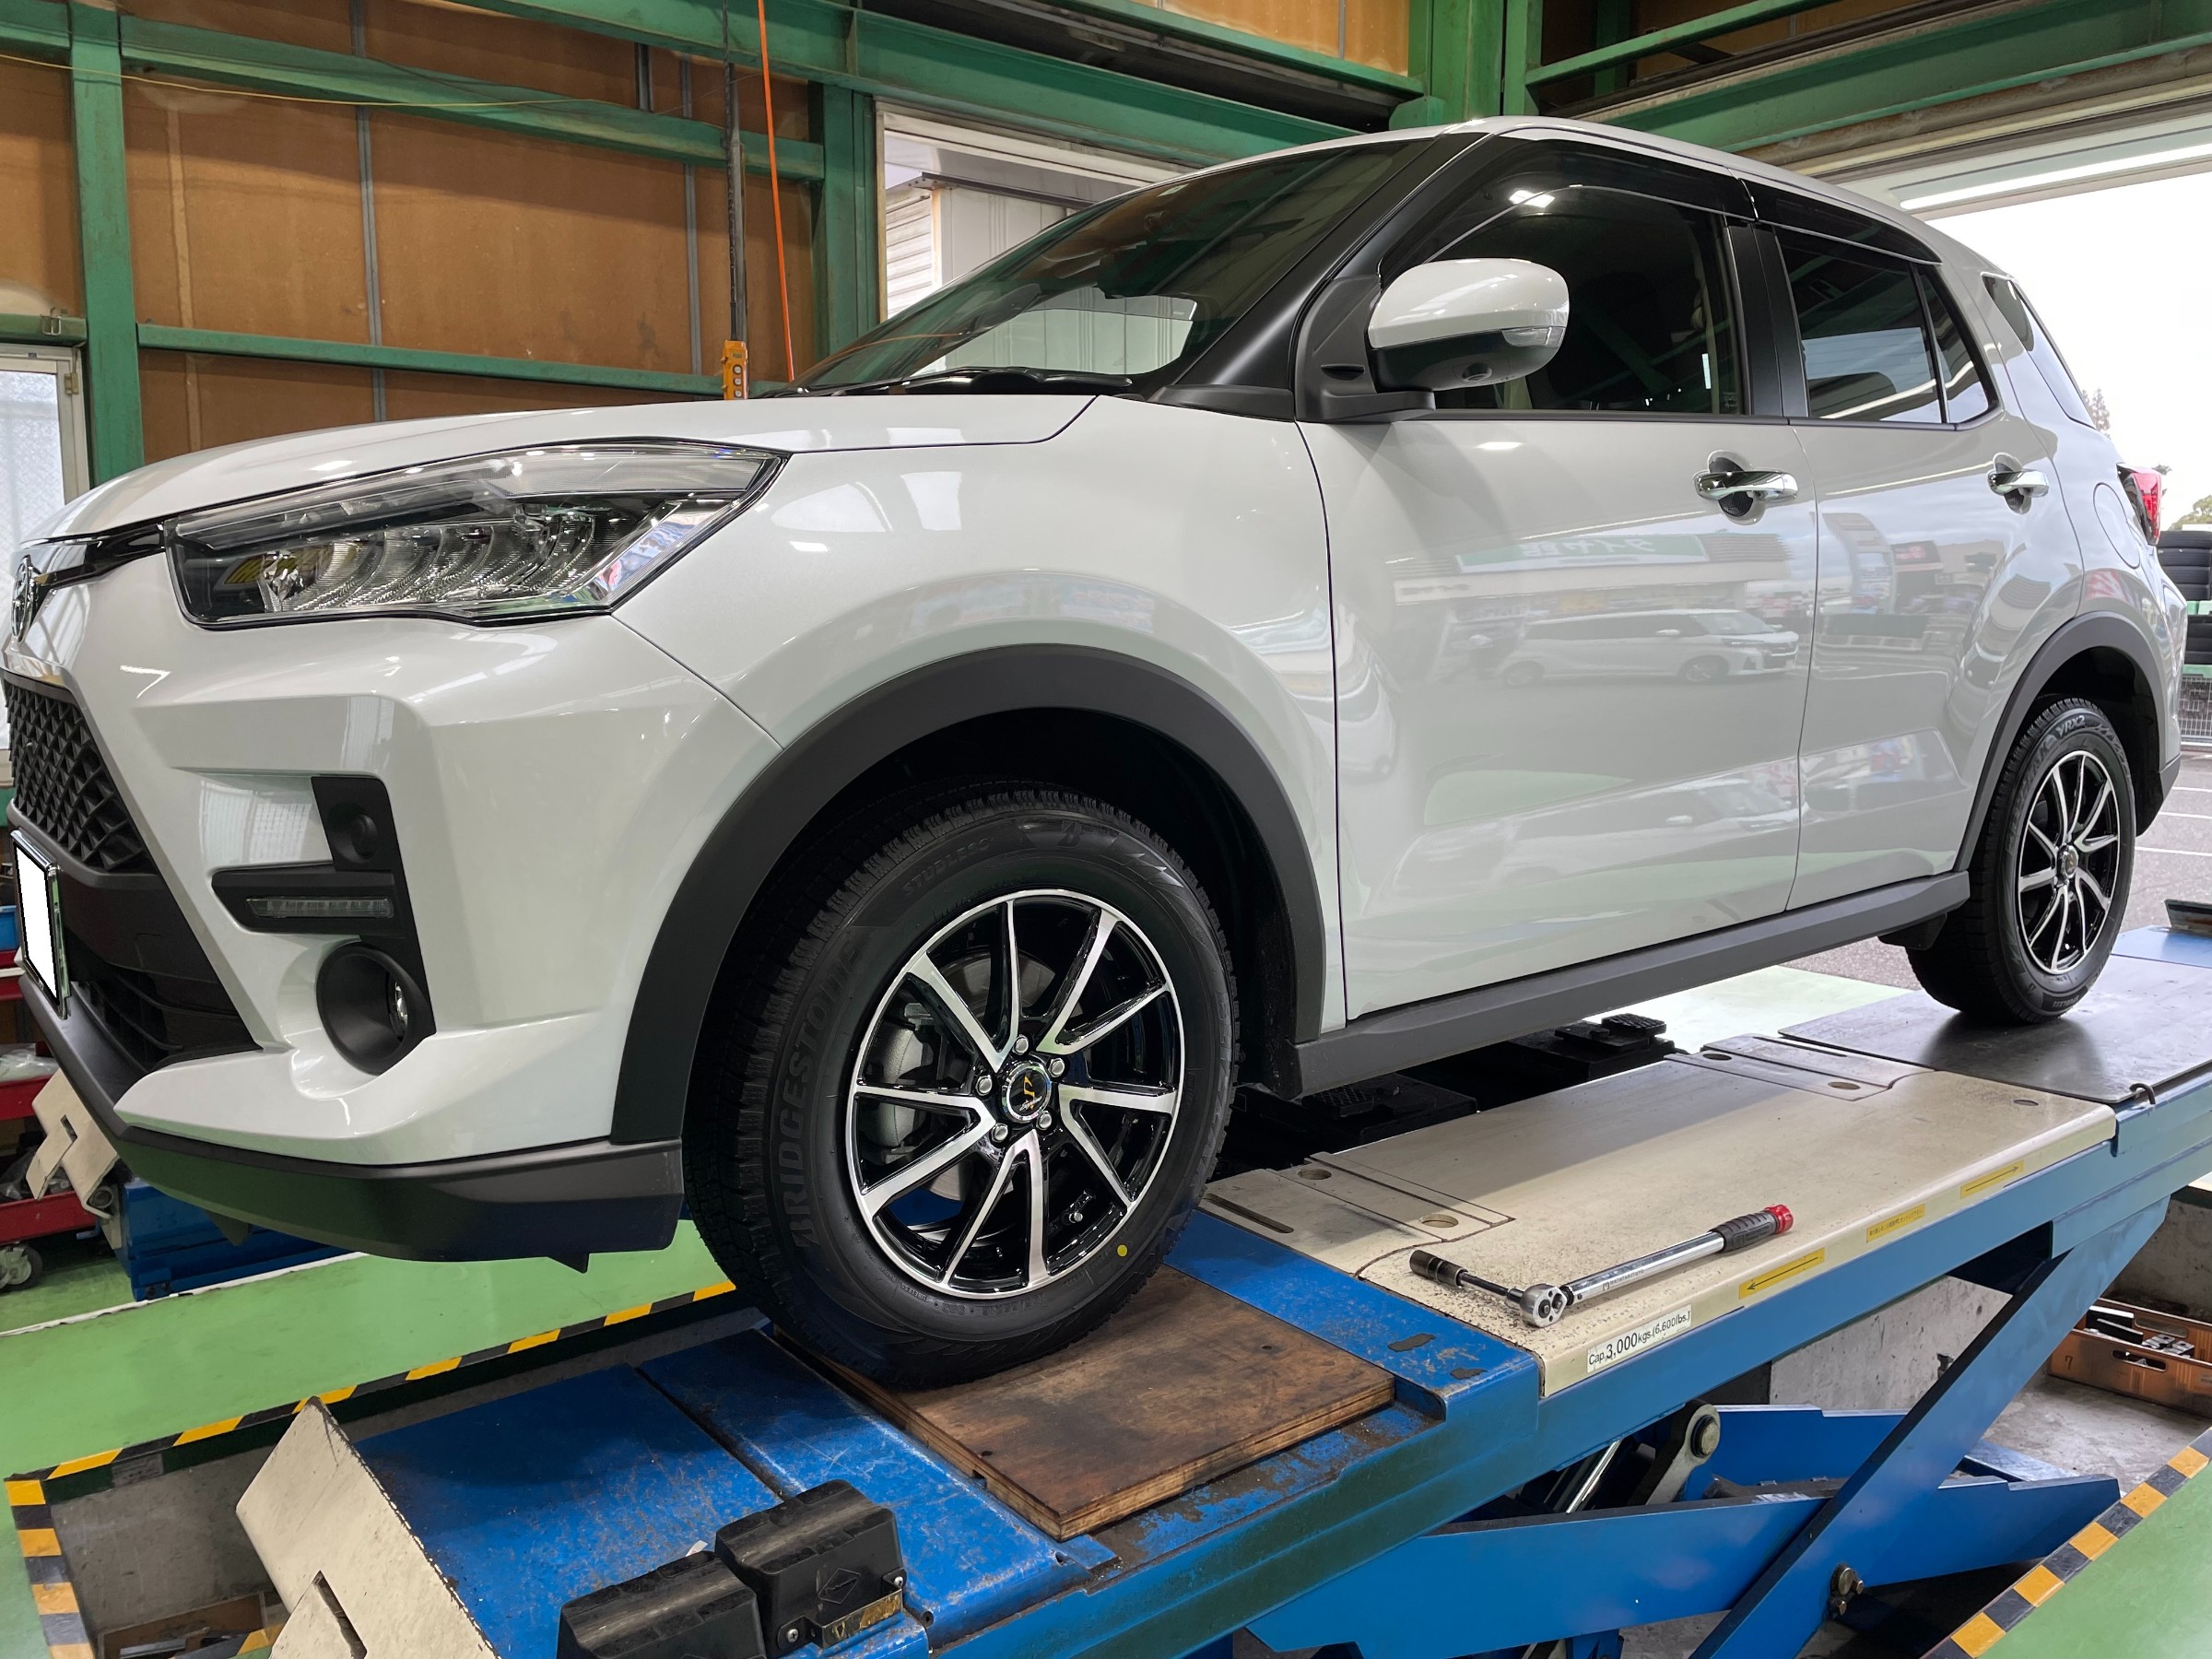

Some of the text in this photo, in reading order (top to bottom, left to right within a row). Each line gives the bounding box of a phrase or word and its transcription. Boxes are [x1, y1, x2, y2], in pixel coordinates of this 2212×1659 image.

[2055, 715, 2087, 736] VRX2
[779, 944, 862, 1250] BRIDGESTONE
[2065, 1355, 2074, 1371] 7
